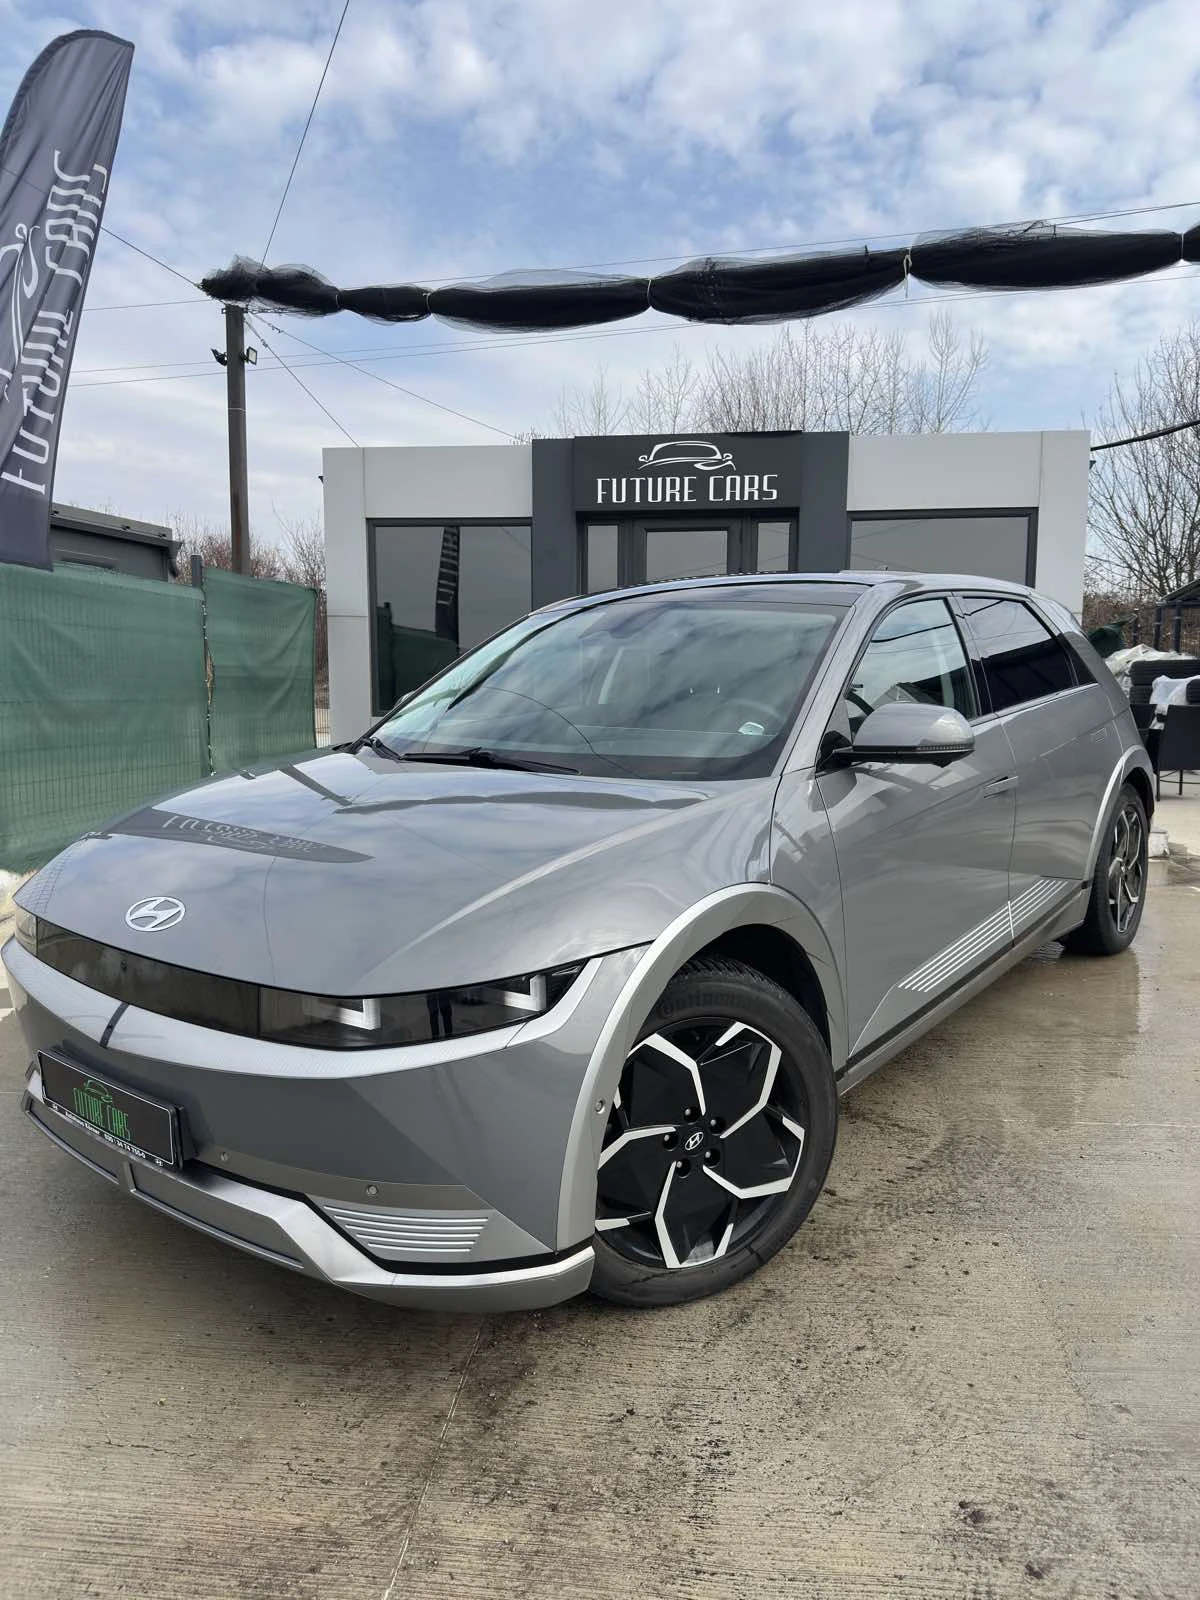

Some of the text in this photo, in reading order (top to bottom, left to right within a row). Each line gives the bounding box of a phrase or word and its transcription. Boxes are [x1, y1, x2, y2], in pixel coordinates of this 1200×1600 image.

[596, 474, 778, 504] FUTURE CARS
[73, 1087, 131, 1142] FUTURE CARS
